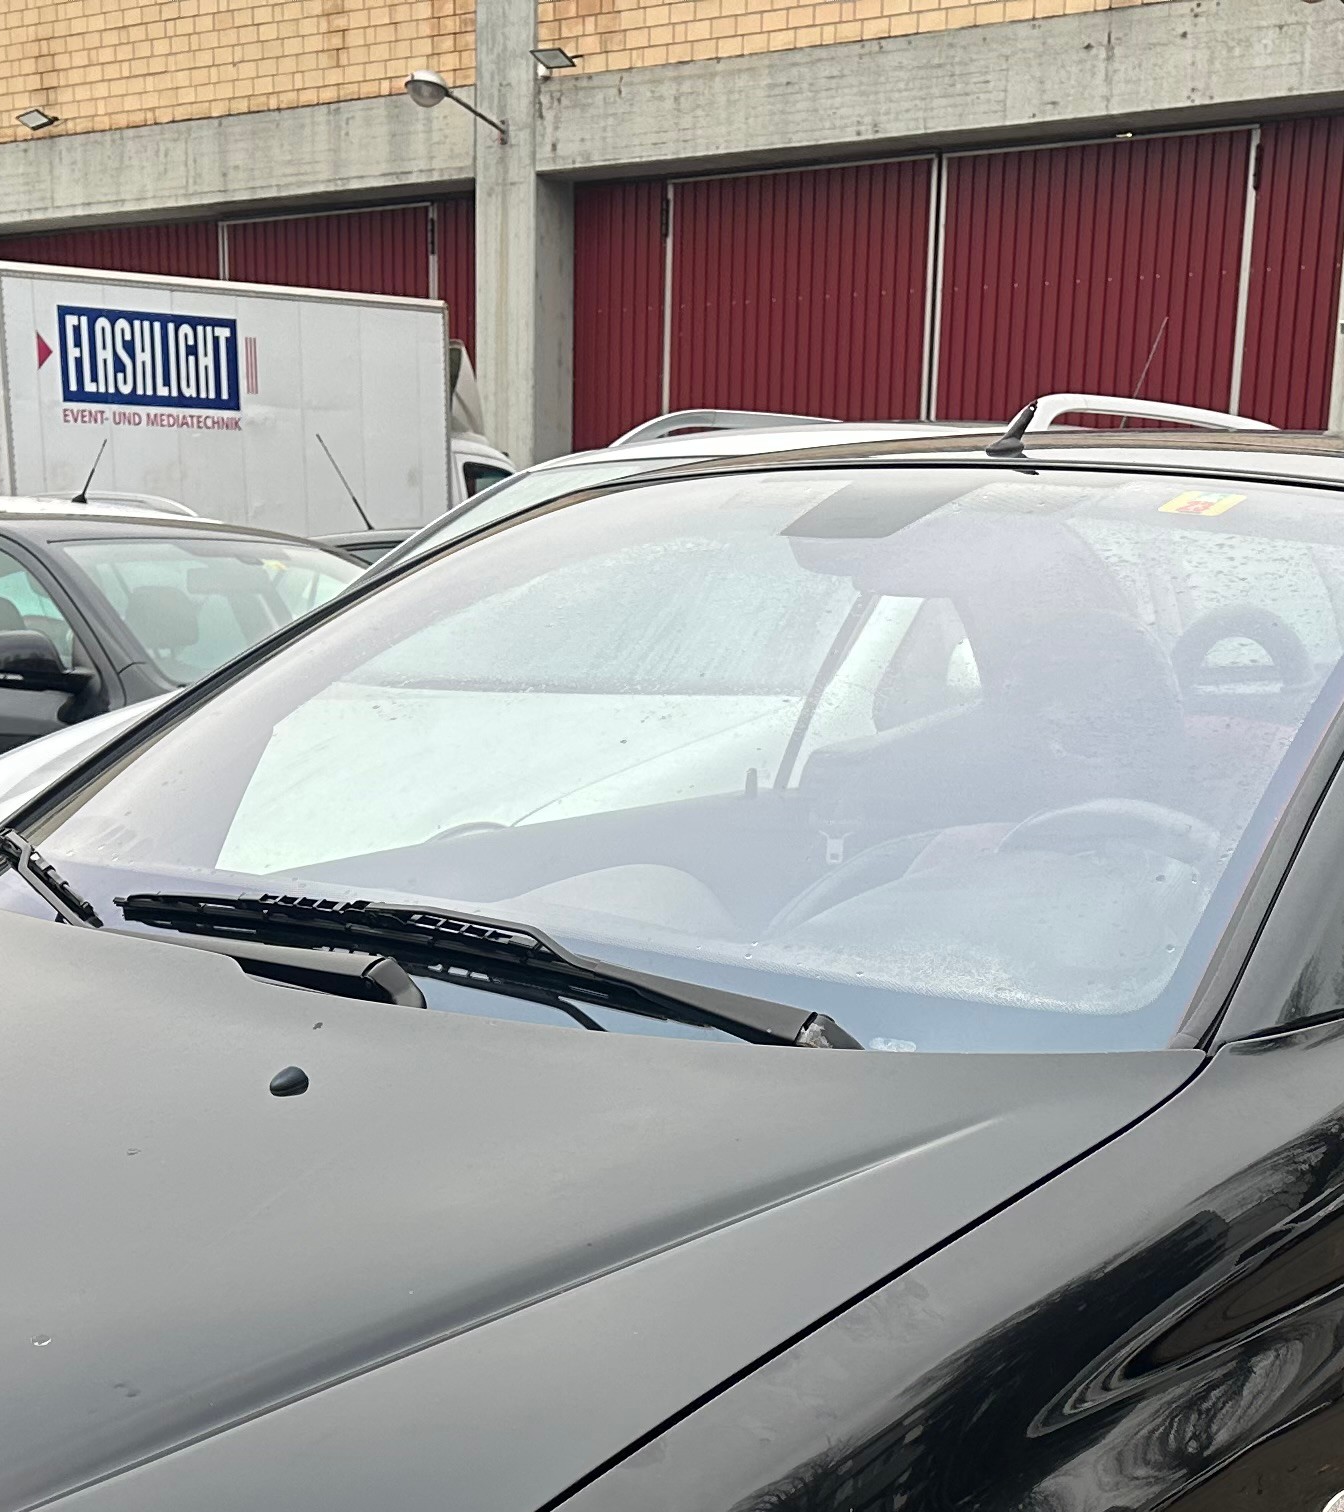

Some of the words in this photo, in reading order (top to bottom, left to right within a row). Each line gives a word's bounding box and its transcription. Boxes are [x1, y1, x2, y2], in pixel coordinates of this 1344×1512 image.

[64, 313, 231, 400] FLASHLIGHT
[62, 408, 109, 425] EVENT-
[112, 411, 142, 426] UND
[145, 412, 242, 431] MEDIATECHNIK
